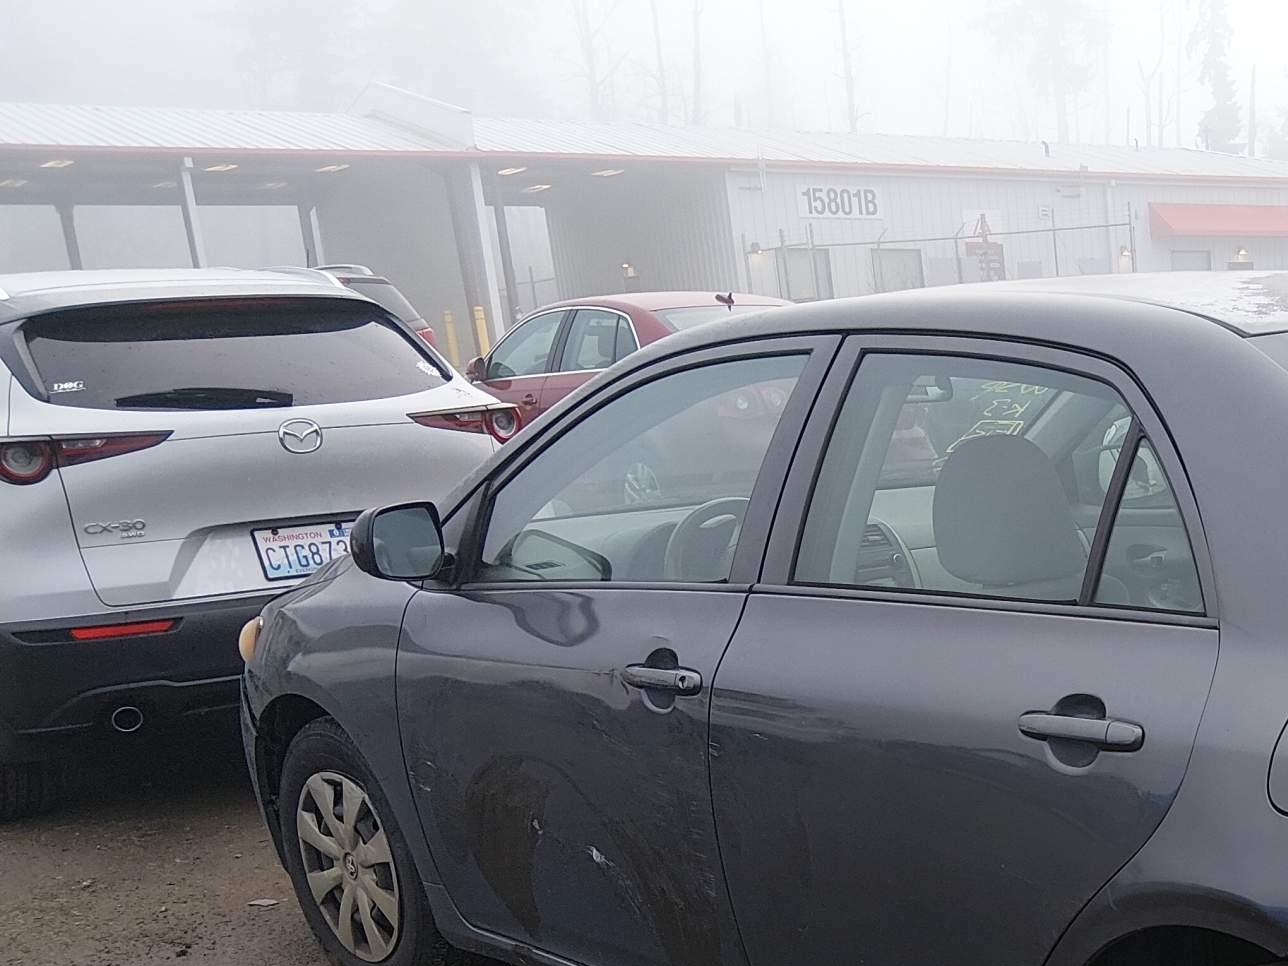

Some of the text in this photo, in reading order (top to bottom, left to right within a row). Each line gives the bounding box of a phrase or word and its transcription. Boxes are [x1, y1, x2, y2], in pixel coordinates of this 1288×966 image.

[801, 187, 878, 216] 15801B
[83, 518, 146, 535] CX-30
[263, 531, 323, 544] WASHINGTON
